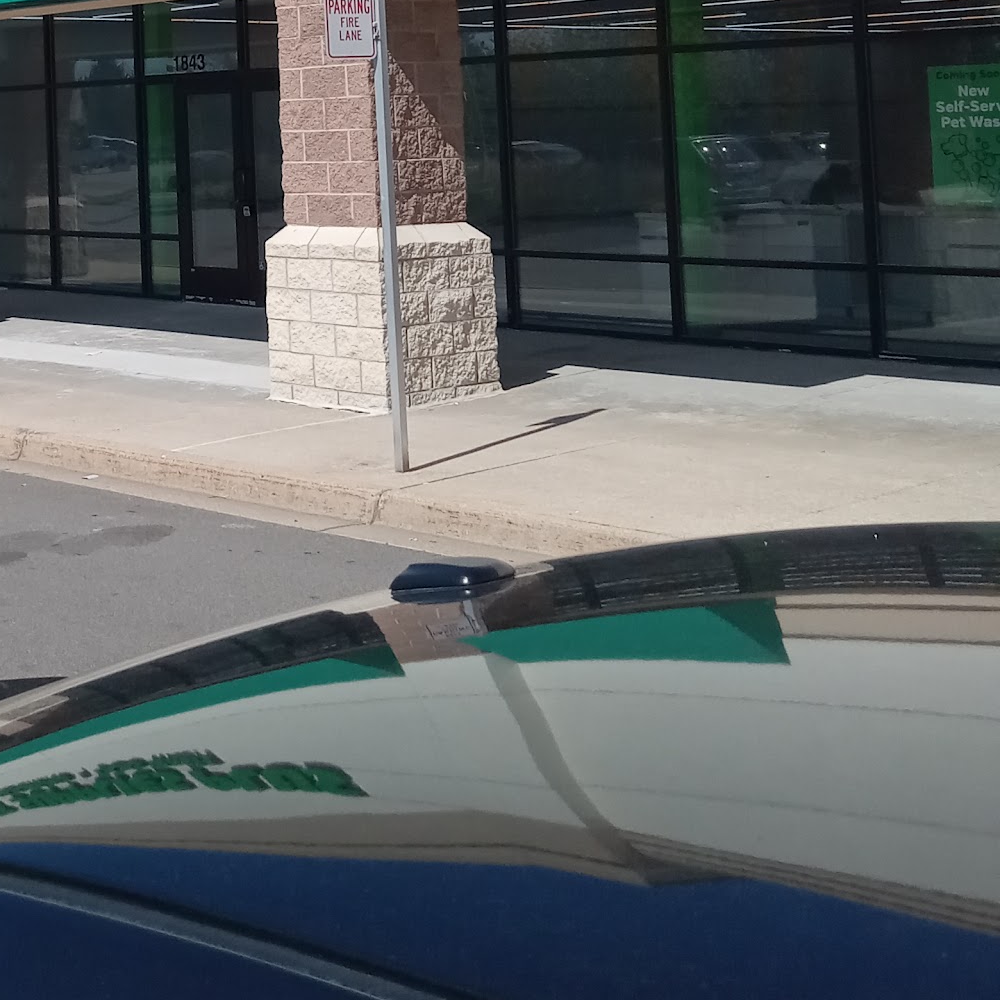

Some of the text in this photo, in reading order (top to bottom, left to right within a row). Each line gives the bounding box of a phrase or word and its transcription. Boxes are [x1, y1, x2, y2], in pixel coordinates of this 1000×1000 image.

[340, 16, 360, 28] FIRE
[339, 30, 362, 41] LANE
[173, 53, 206, 72] 1843
[957, 84, 990, 97] New
[940, 116, 967, 128] Pet
